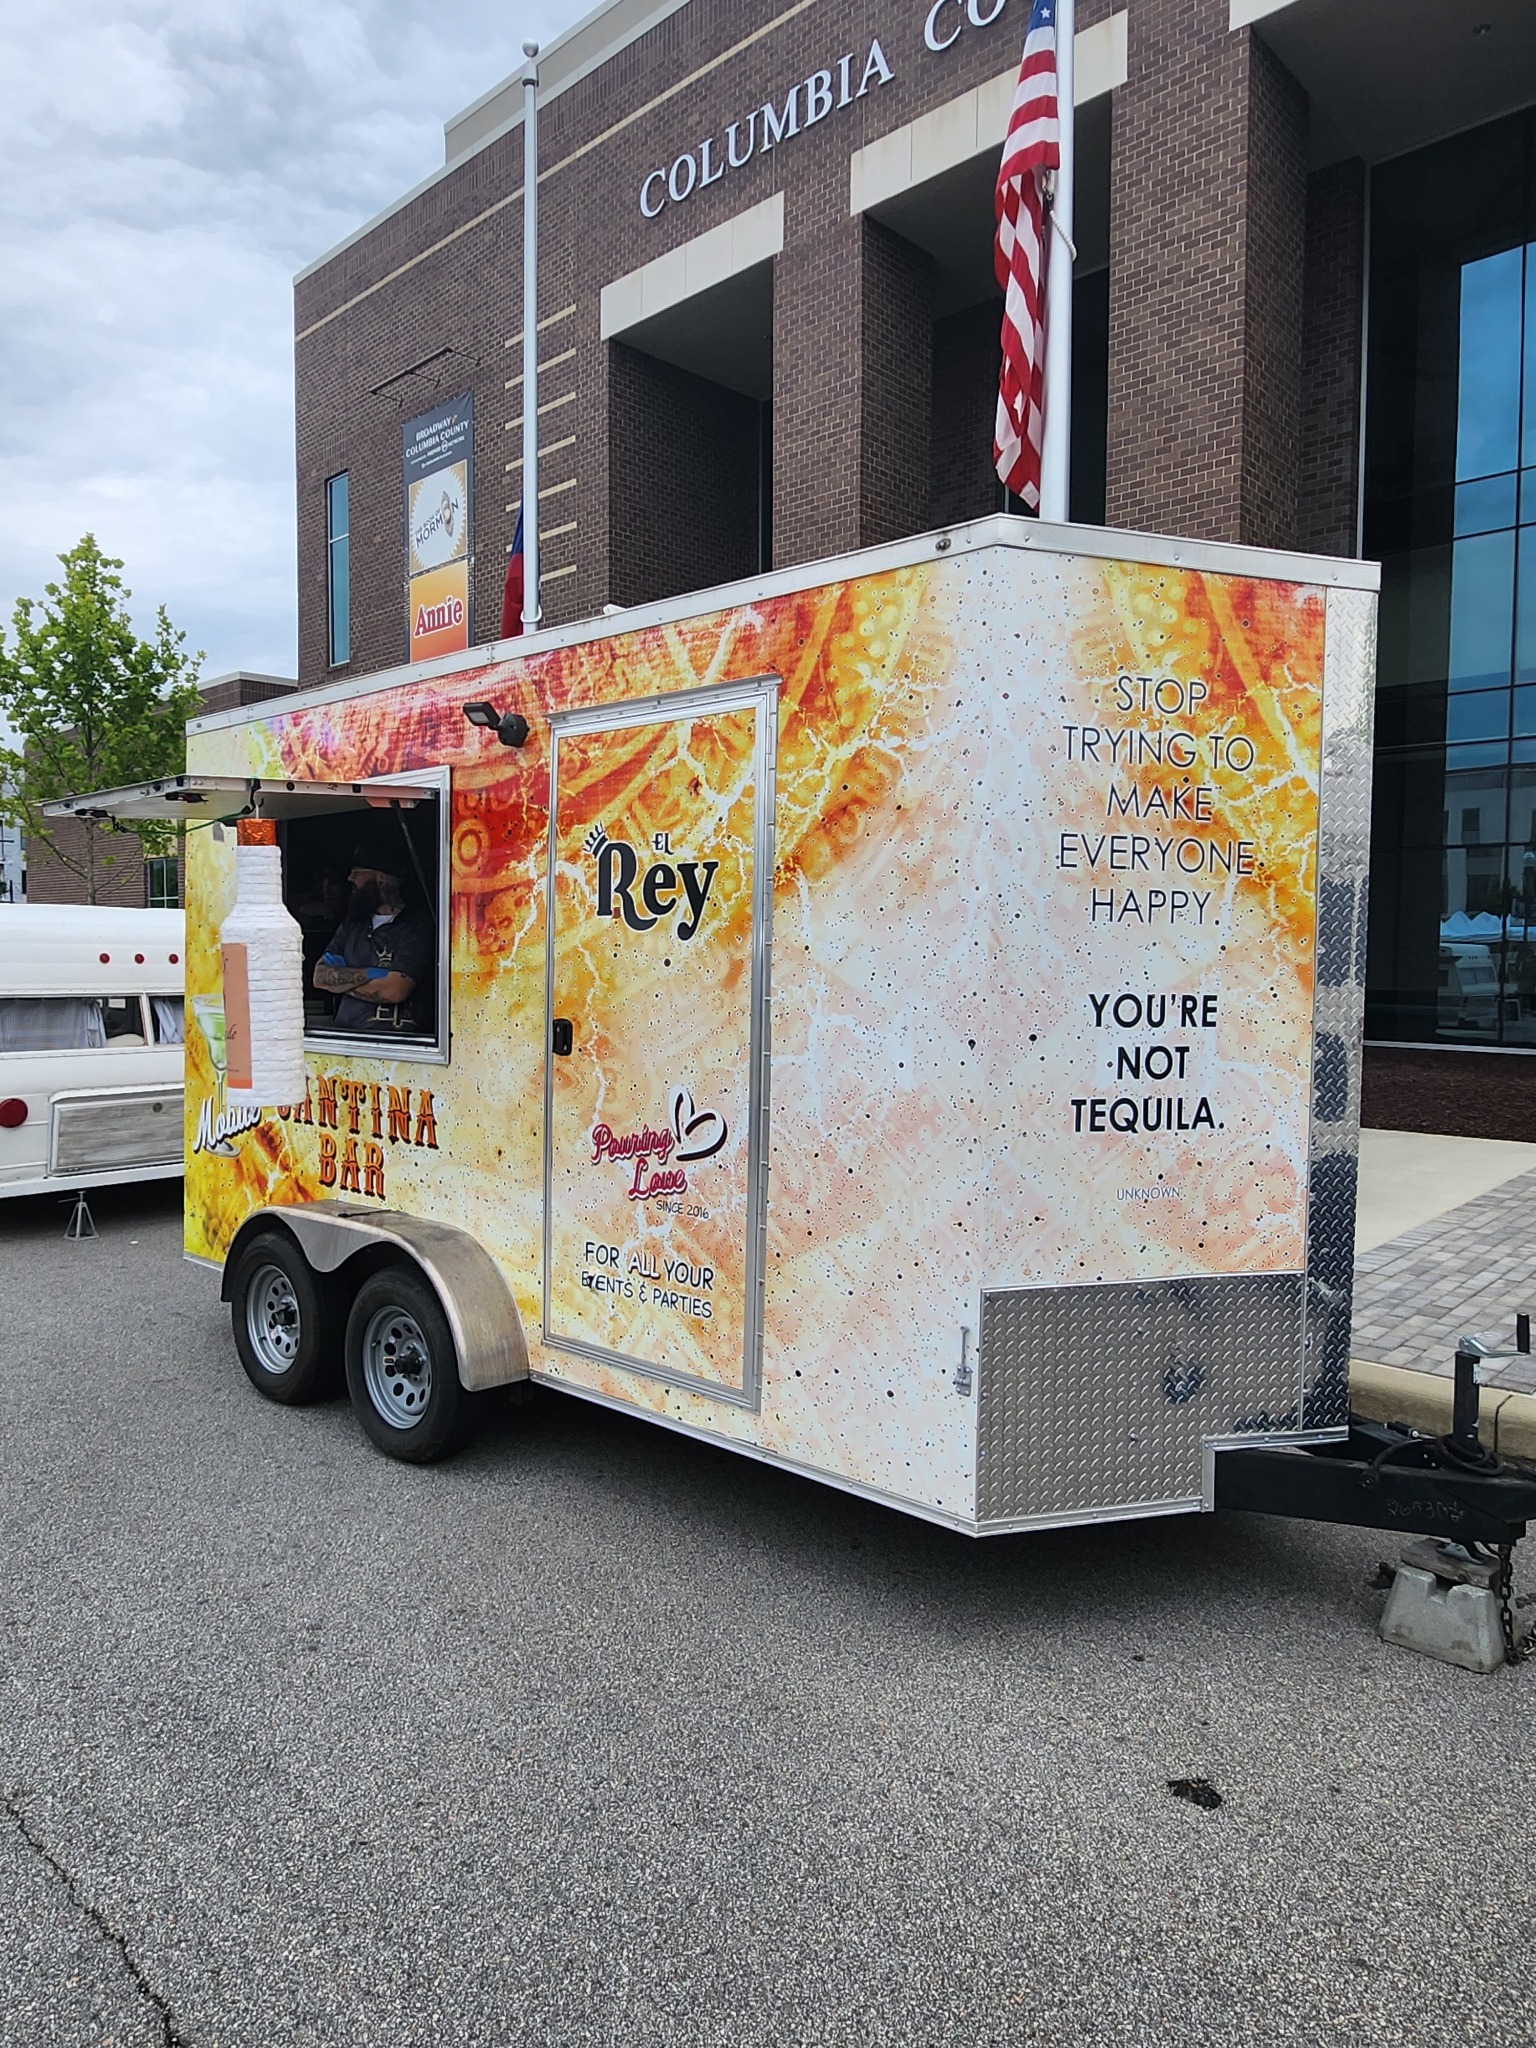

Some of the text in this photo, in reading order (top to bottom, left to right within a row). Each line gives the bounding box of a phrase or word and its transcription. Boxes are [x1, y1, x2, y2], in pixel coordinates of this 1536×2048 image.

[639, 37, 895, 219] COLUMBIA
[405, 419, 470, 458] COLUMBIA COUNTY
[415, 416, 452, 442] BROADWAY
[413, 596, 463, 638] Annie
[1115, 675, 1207, 715] STOP
[1062, 725, 1255, 772] TRYING TO
[1106, 783, 1213, 821] MAKE
[1059, 833, 1255, 875] EVERYONE
[597, 841, 720, 942] Rey
[1088, 992, 1219, 1029] YOU'RE
[1116, 1046, 1190, 1080] NOT
[591, 1122, 676, 1166] Pouring
[318, 1131, 386, 1200] BAR
[628, 1157, 688, 1201] Love
[656, 1200, 709, 1219] SINCE 2016
[1117, 1186, 1181, 1201] UNKNOWN
[585, 1241, 714, 1291] FOR ALL YOUR
[581, 1271, 713, 1319] EVENTS & PARTIES
